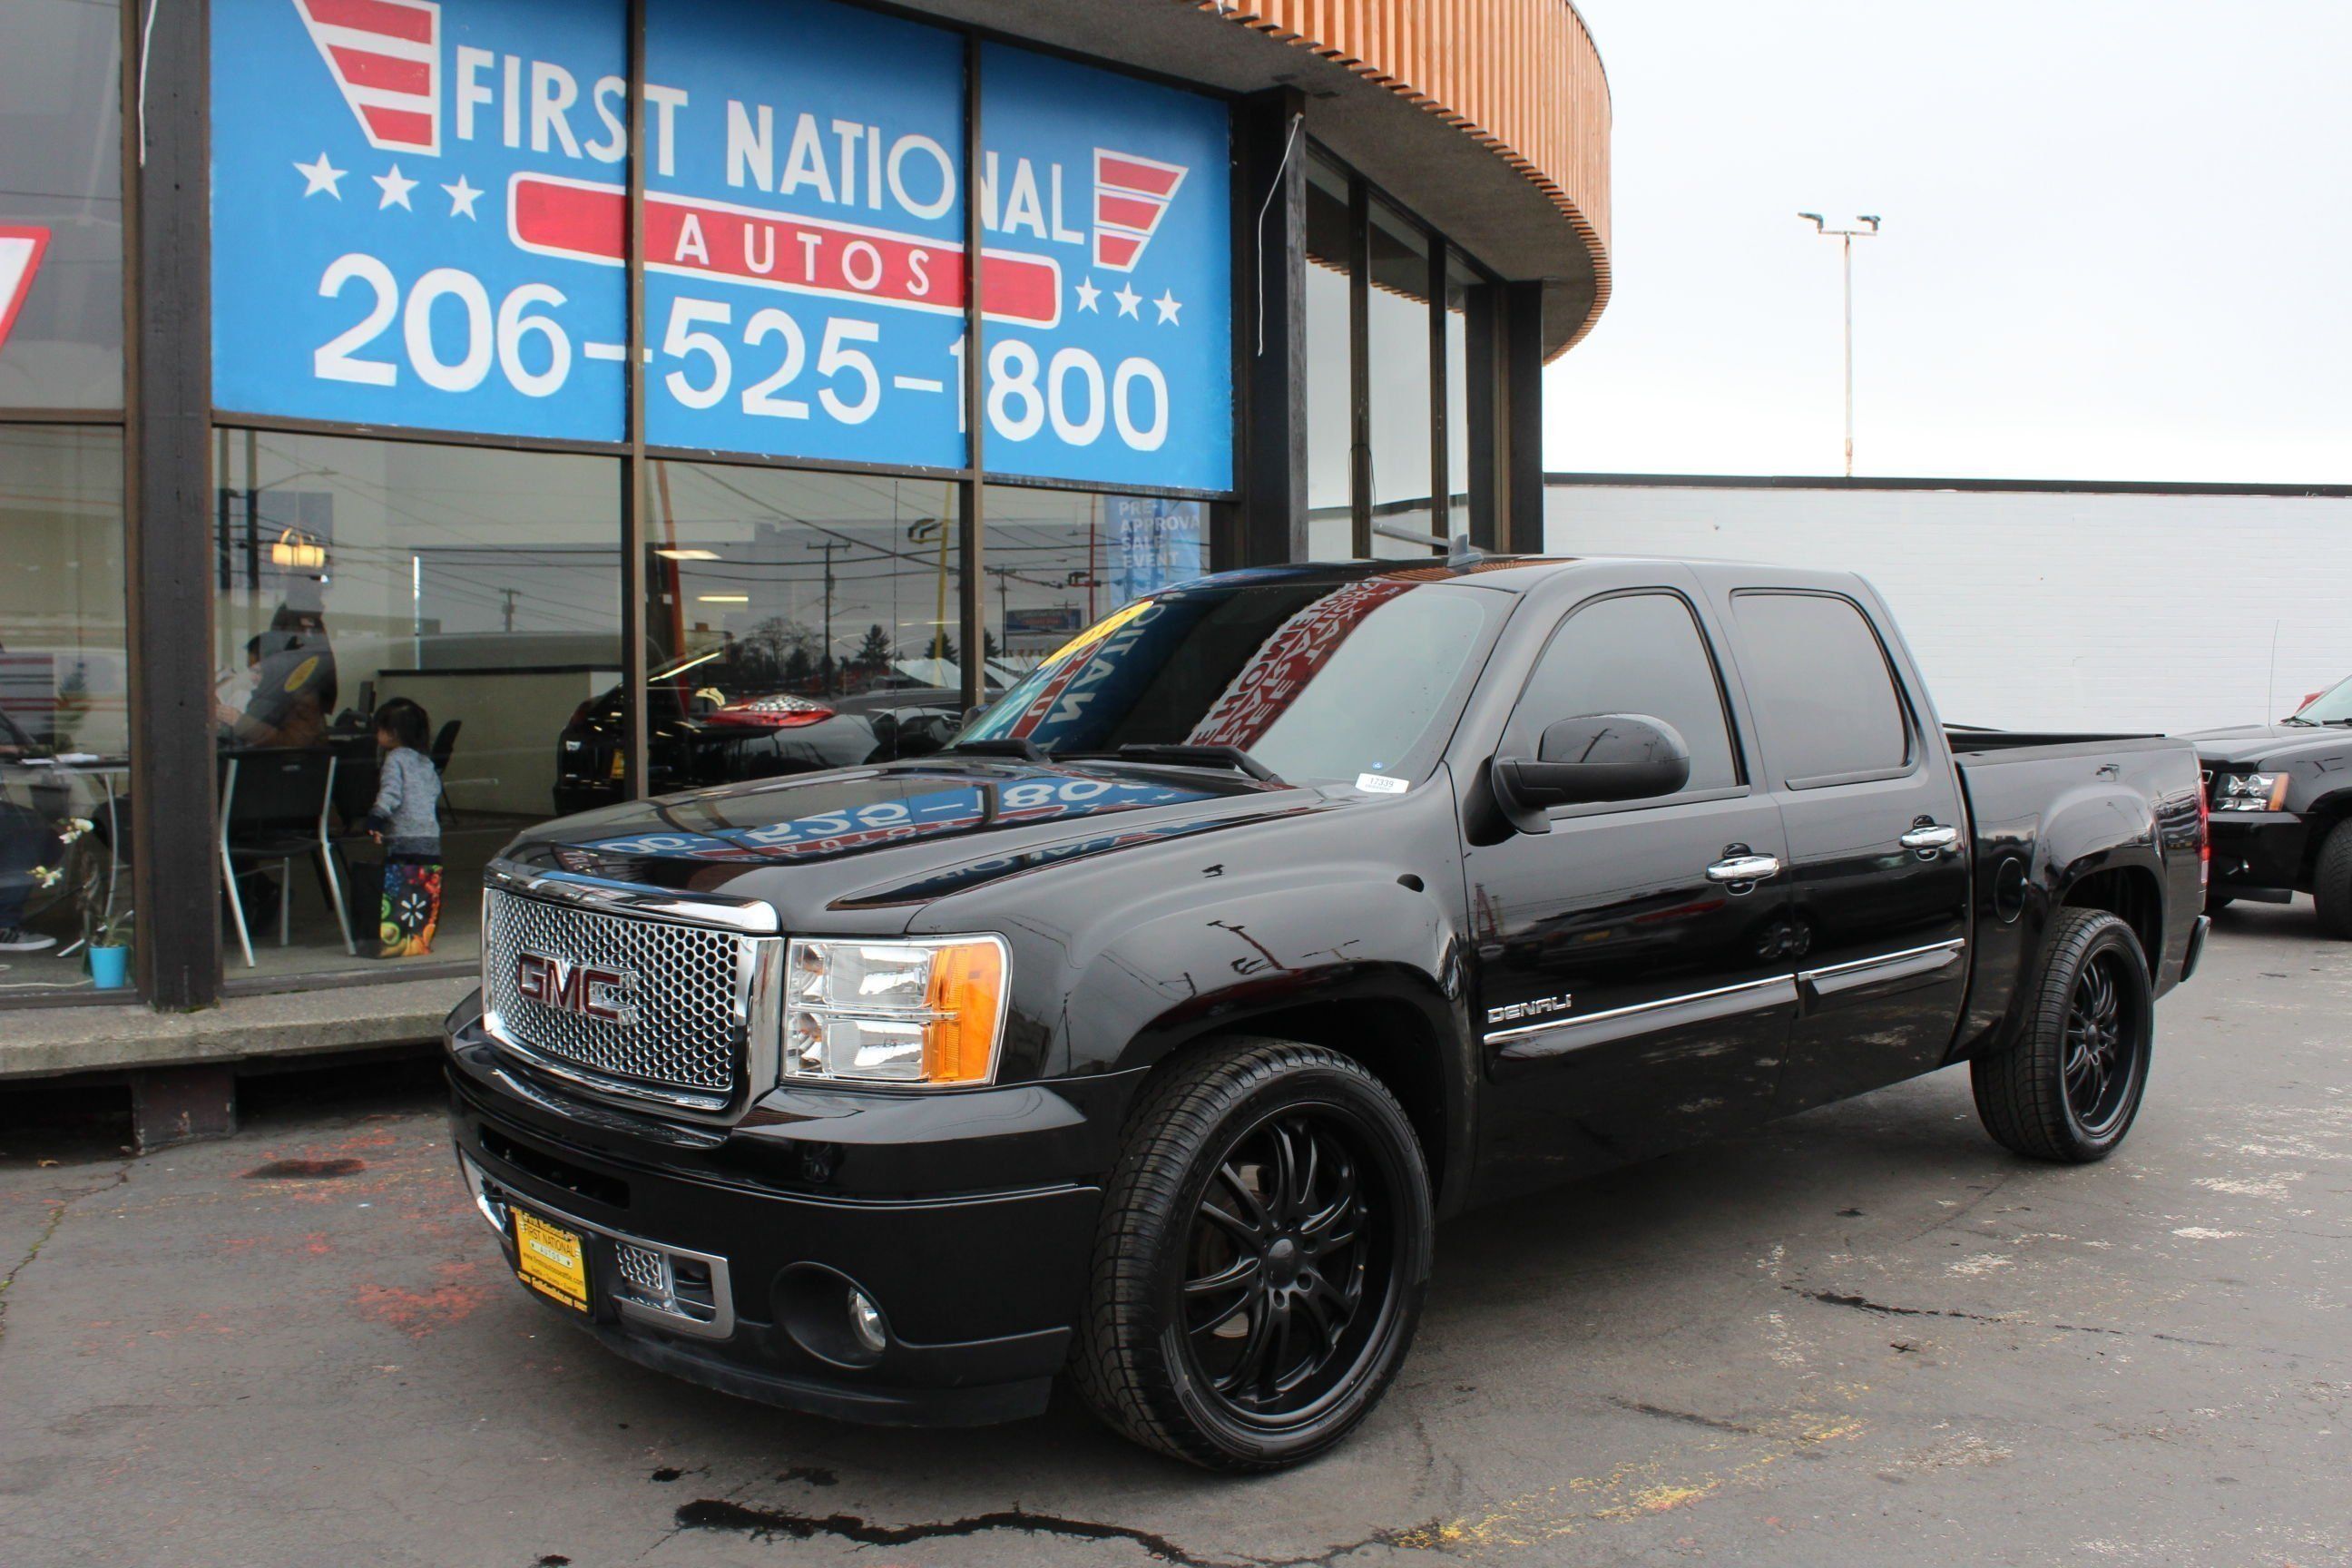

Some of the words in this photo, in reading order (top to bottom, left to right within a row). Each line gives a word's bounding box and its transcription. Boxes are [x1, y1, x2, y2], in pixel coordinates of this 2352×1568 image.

[456, 44, 689, 177] FIRST
[727, 100, 1085, 246] NATIONAL
[675, 213, 931, 298] AUTOS
[314, 252, 1170, 452] 206-525-1800
[1122, 535, 1164, 552] SALE
[1123, 551, 1180, 569] EVENT
[517, 948, 637, 1025] GMC
[1487, 994, 1572, 1024] DENALI
[543, 1232, 576, 1258] NATIONAL
